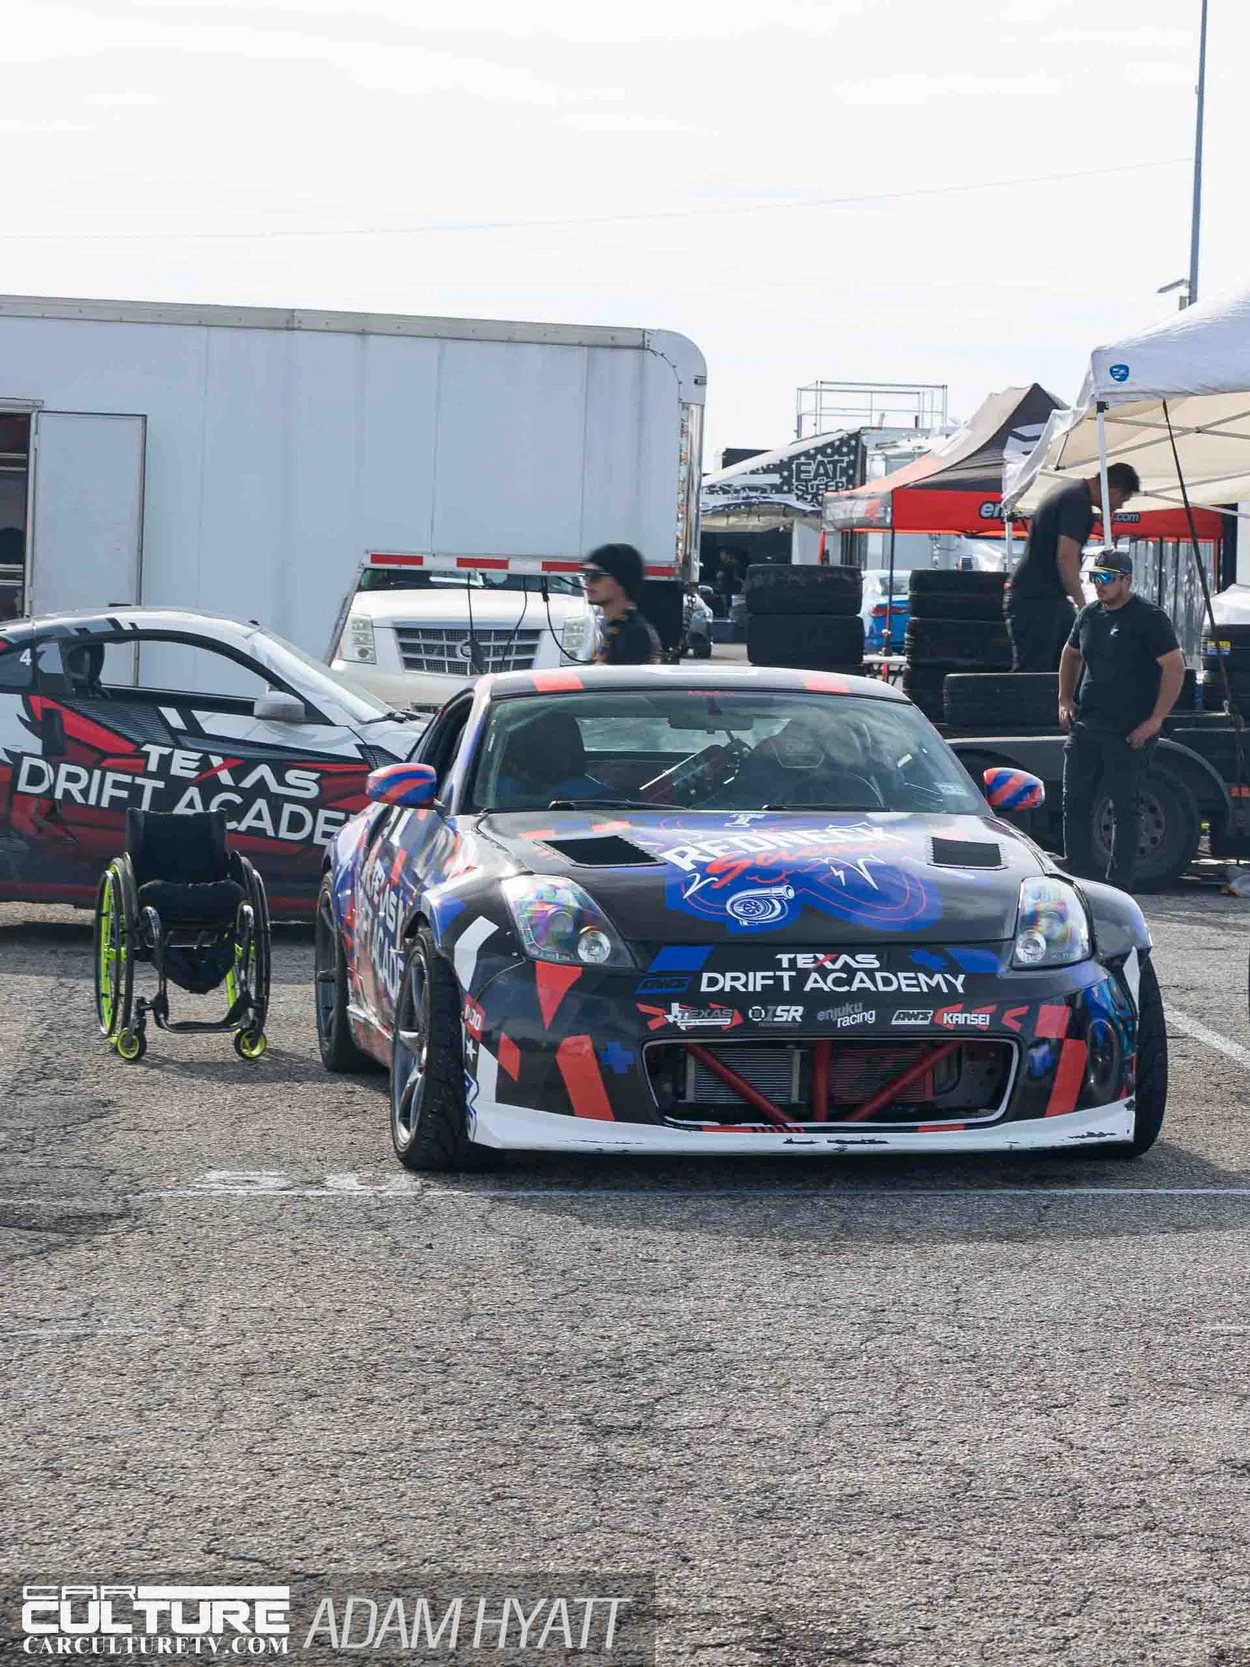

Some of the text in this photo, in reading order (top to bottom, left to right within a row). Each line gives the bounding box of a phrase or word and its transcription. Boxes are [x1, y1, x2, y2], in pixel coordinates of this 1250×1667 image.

[793, 457, 849, 482] EAT
[19, 649, 32, 666] 4
[139, 744, 321, 799] TEXAS
[16, 756, 356, 847] DRIFT ACADE
[775, 953, 881, 970] TEXAS
[700, 971, 966, 994] DRIFT ACADEMY
[817, 1001, 864, 1021] enjuku
[837, 1009, 876, 1029] racing
[943, 1012, 990, 1026] KANSEI
